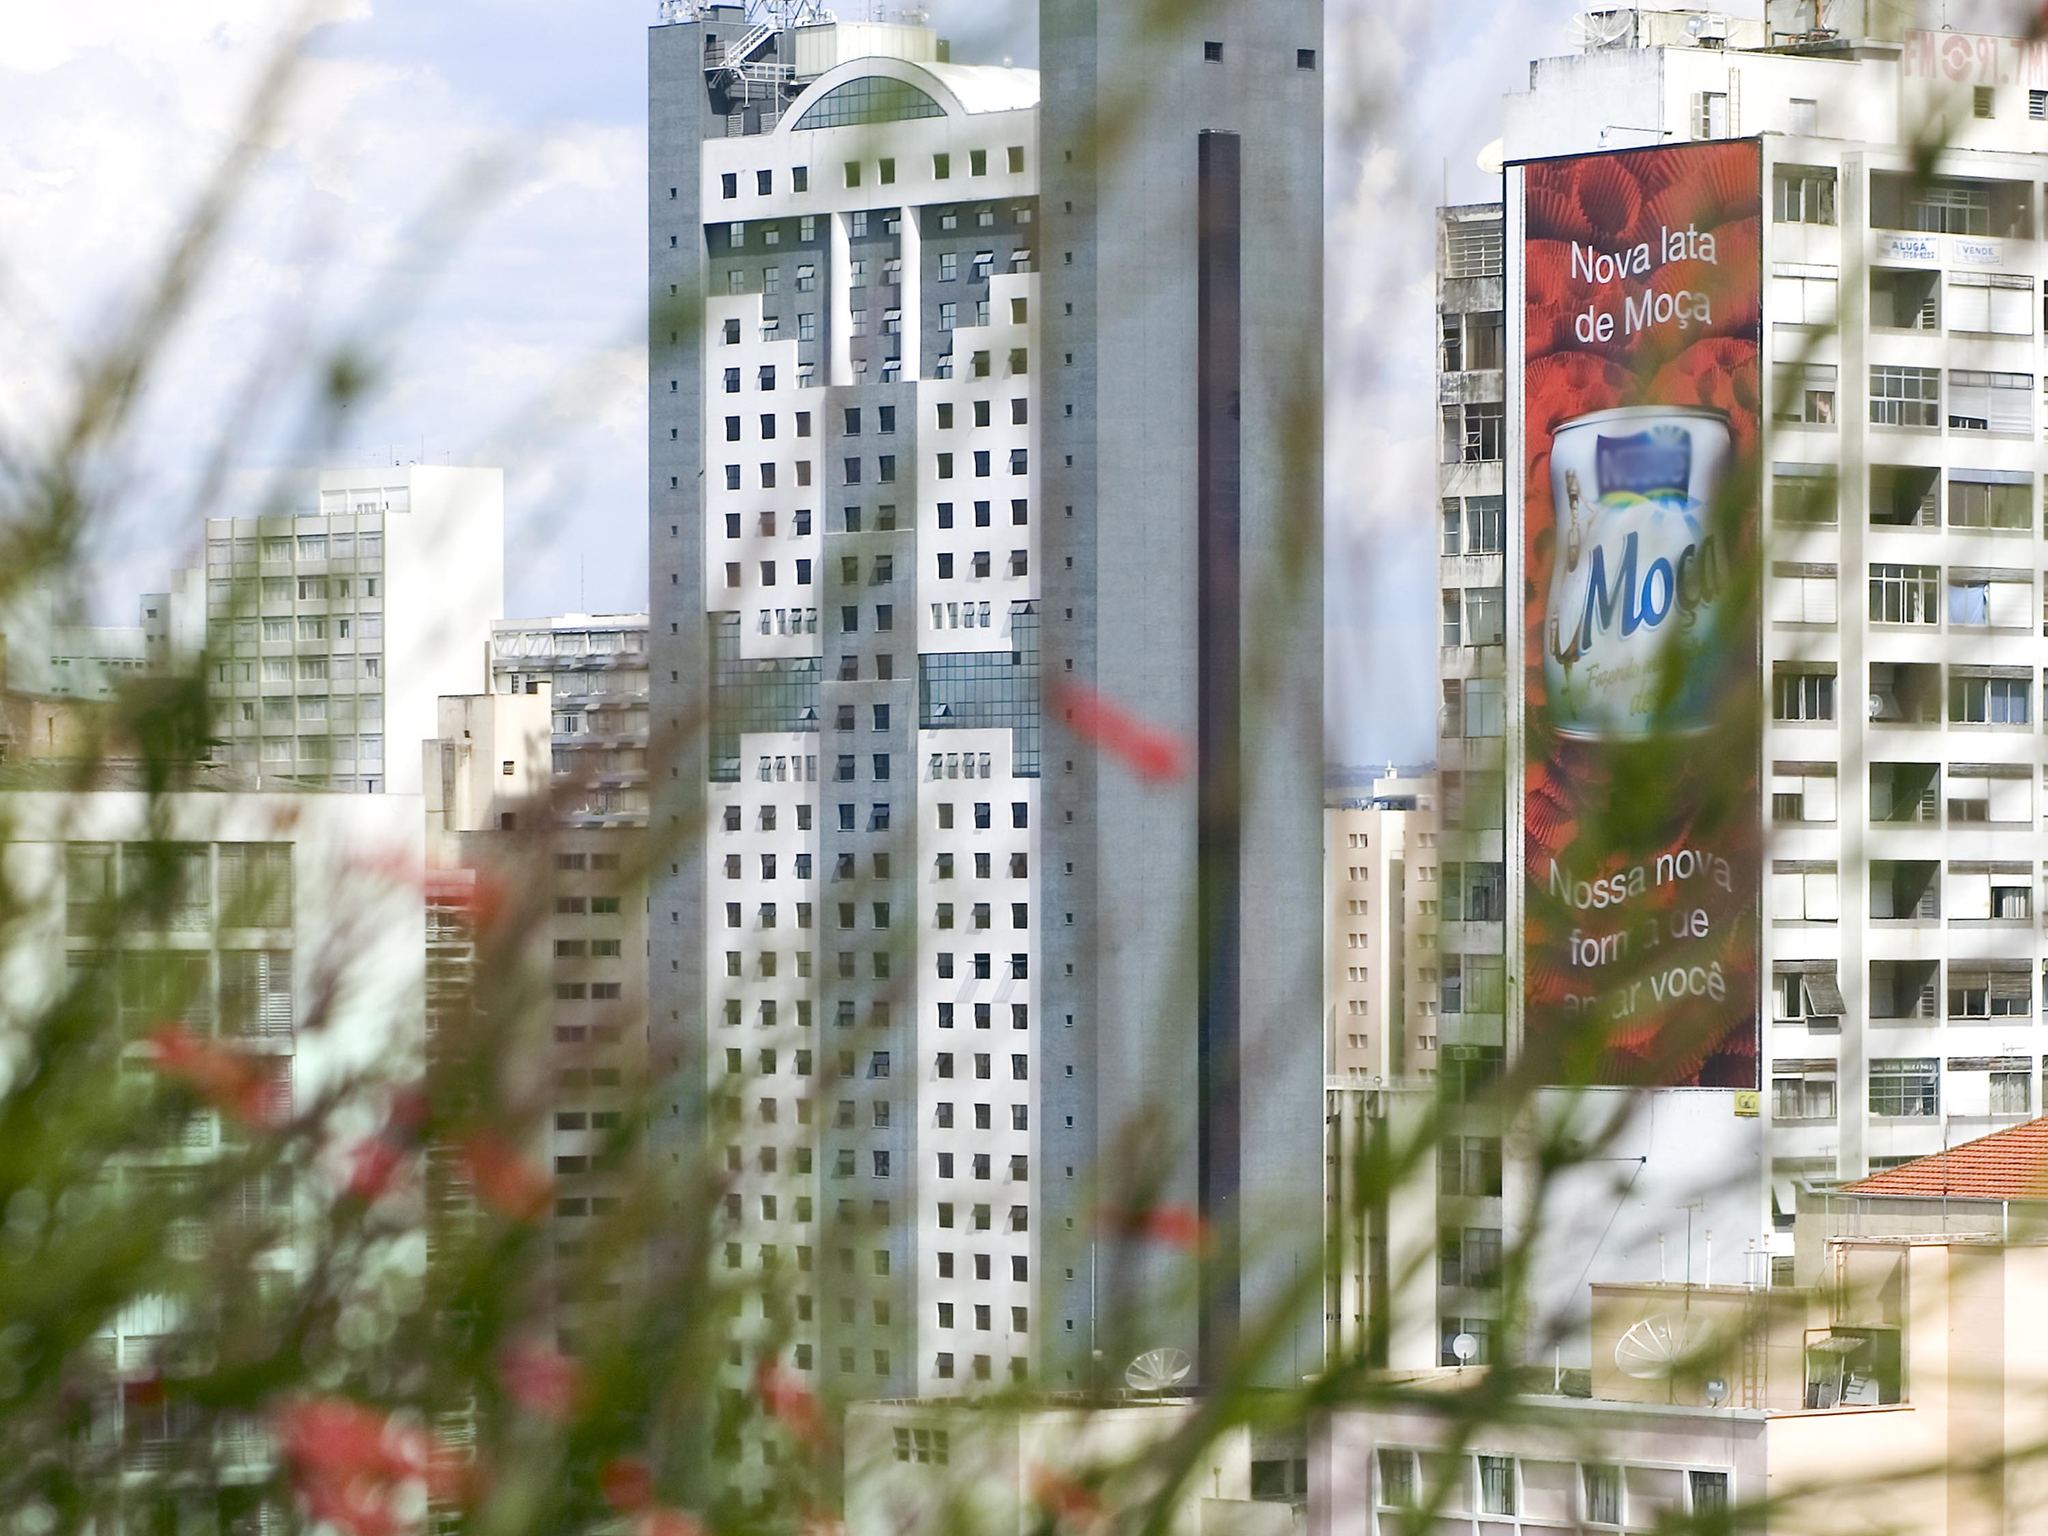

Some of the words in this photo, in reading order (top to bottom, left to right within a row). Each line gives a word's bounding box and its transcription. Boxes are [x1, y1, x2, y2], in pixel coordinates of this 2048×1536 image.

[1571, 240, 1650, 285] Nova
[1661, 223, 1717, 265] lata
[1890, 240, 1927, 252] ALUGA
[1963, 246, 1994, 255] VENDE
[1575, 305, 1614, 343] de
[1625, 288, 1712, 335] Moça
[1550, 857, 1646, 910] Nossa
[1656, 849, 1732, 892] nova
[1651, 961, 1726, 1003] você
